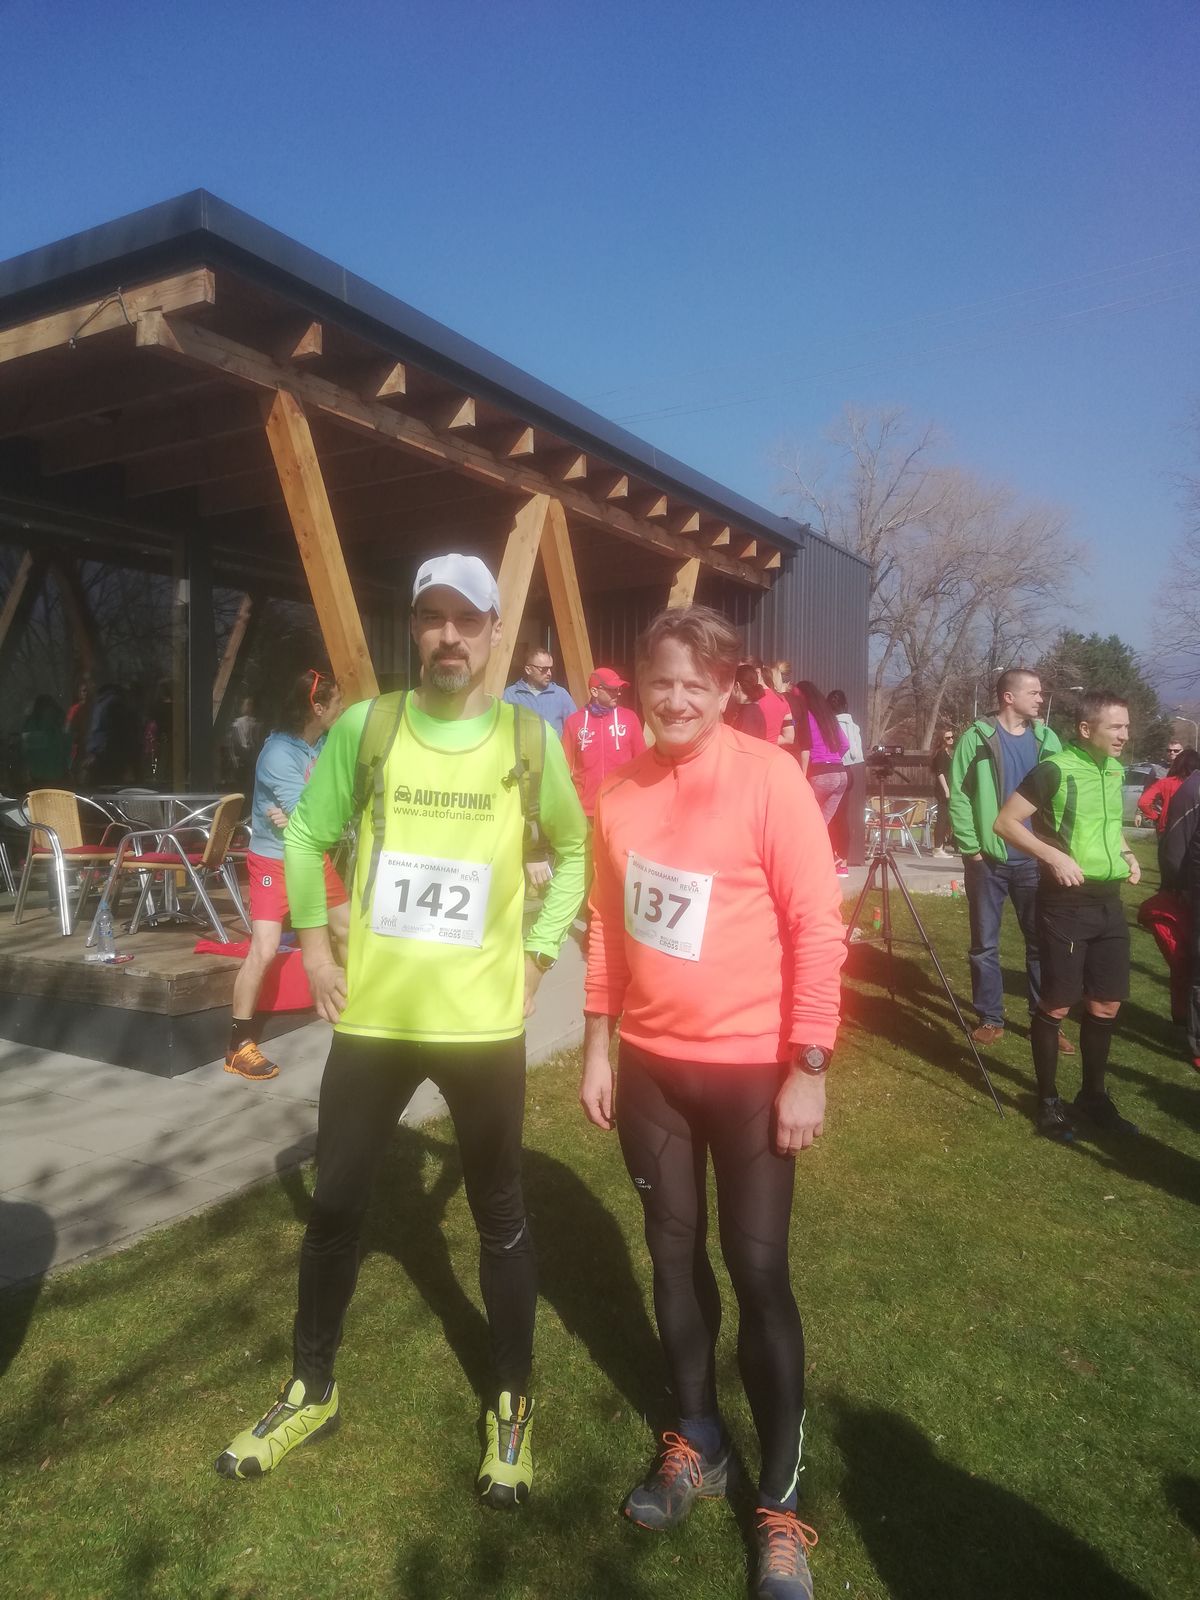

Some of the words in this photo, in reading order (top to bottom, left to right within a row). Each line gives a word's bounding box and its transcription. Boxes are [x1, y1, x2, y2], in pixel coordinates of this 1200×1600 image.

[393, 807, 495, 822] www.autofunia.com
[413, 789, 492, 810] AUTOFUNIA
[394, 878, 471, 921] 142
[633, 881, 692, 930] 137
